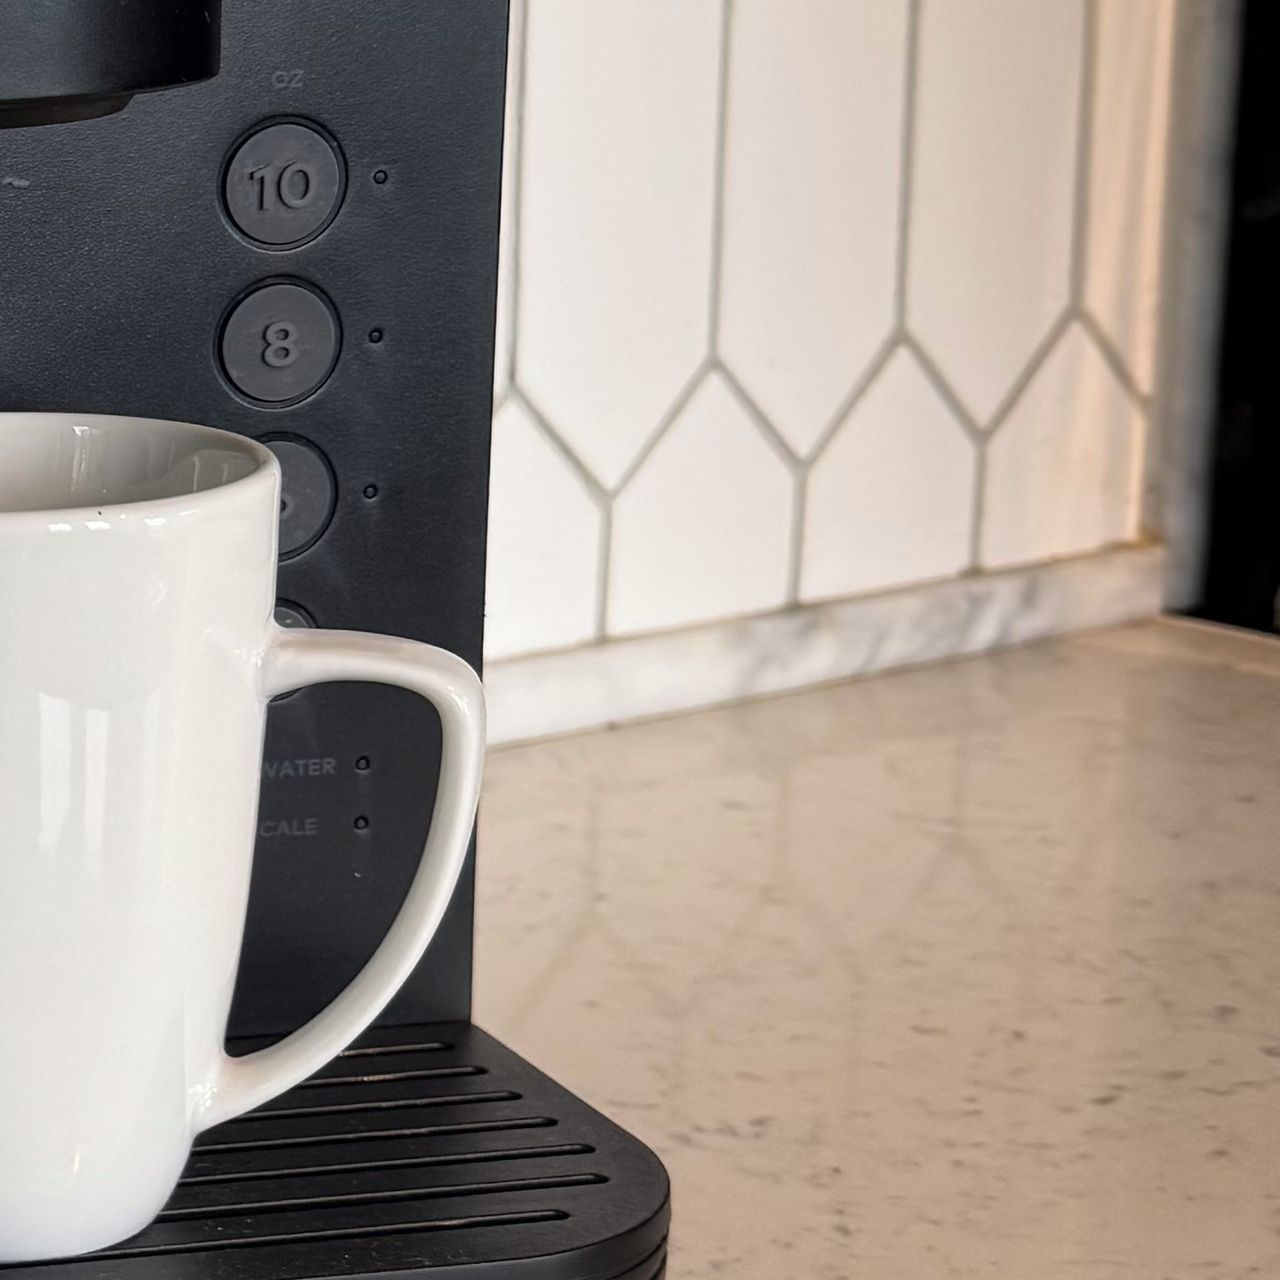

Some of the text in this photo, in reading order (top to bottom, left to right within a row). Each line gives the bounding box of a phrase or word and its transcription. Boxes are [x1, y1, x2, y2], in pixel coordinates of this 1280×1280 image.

[272, 70, 305, 89] oz
[248, 160, 312, 213] 10
[260, 320, 296, 368] 8
